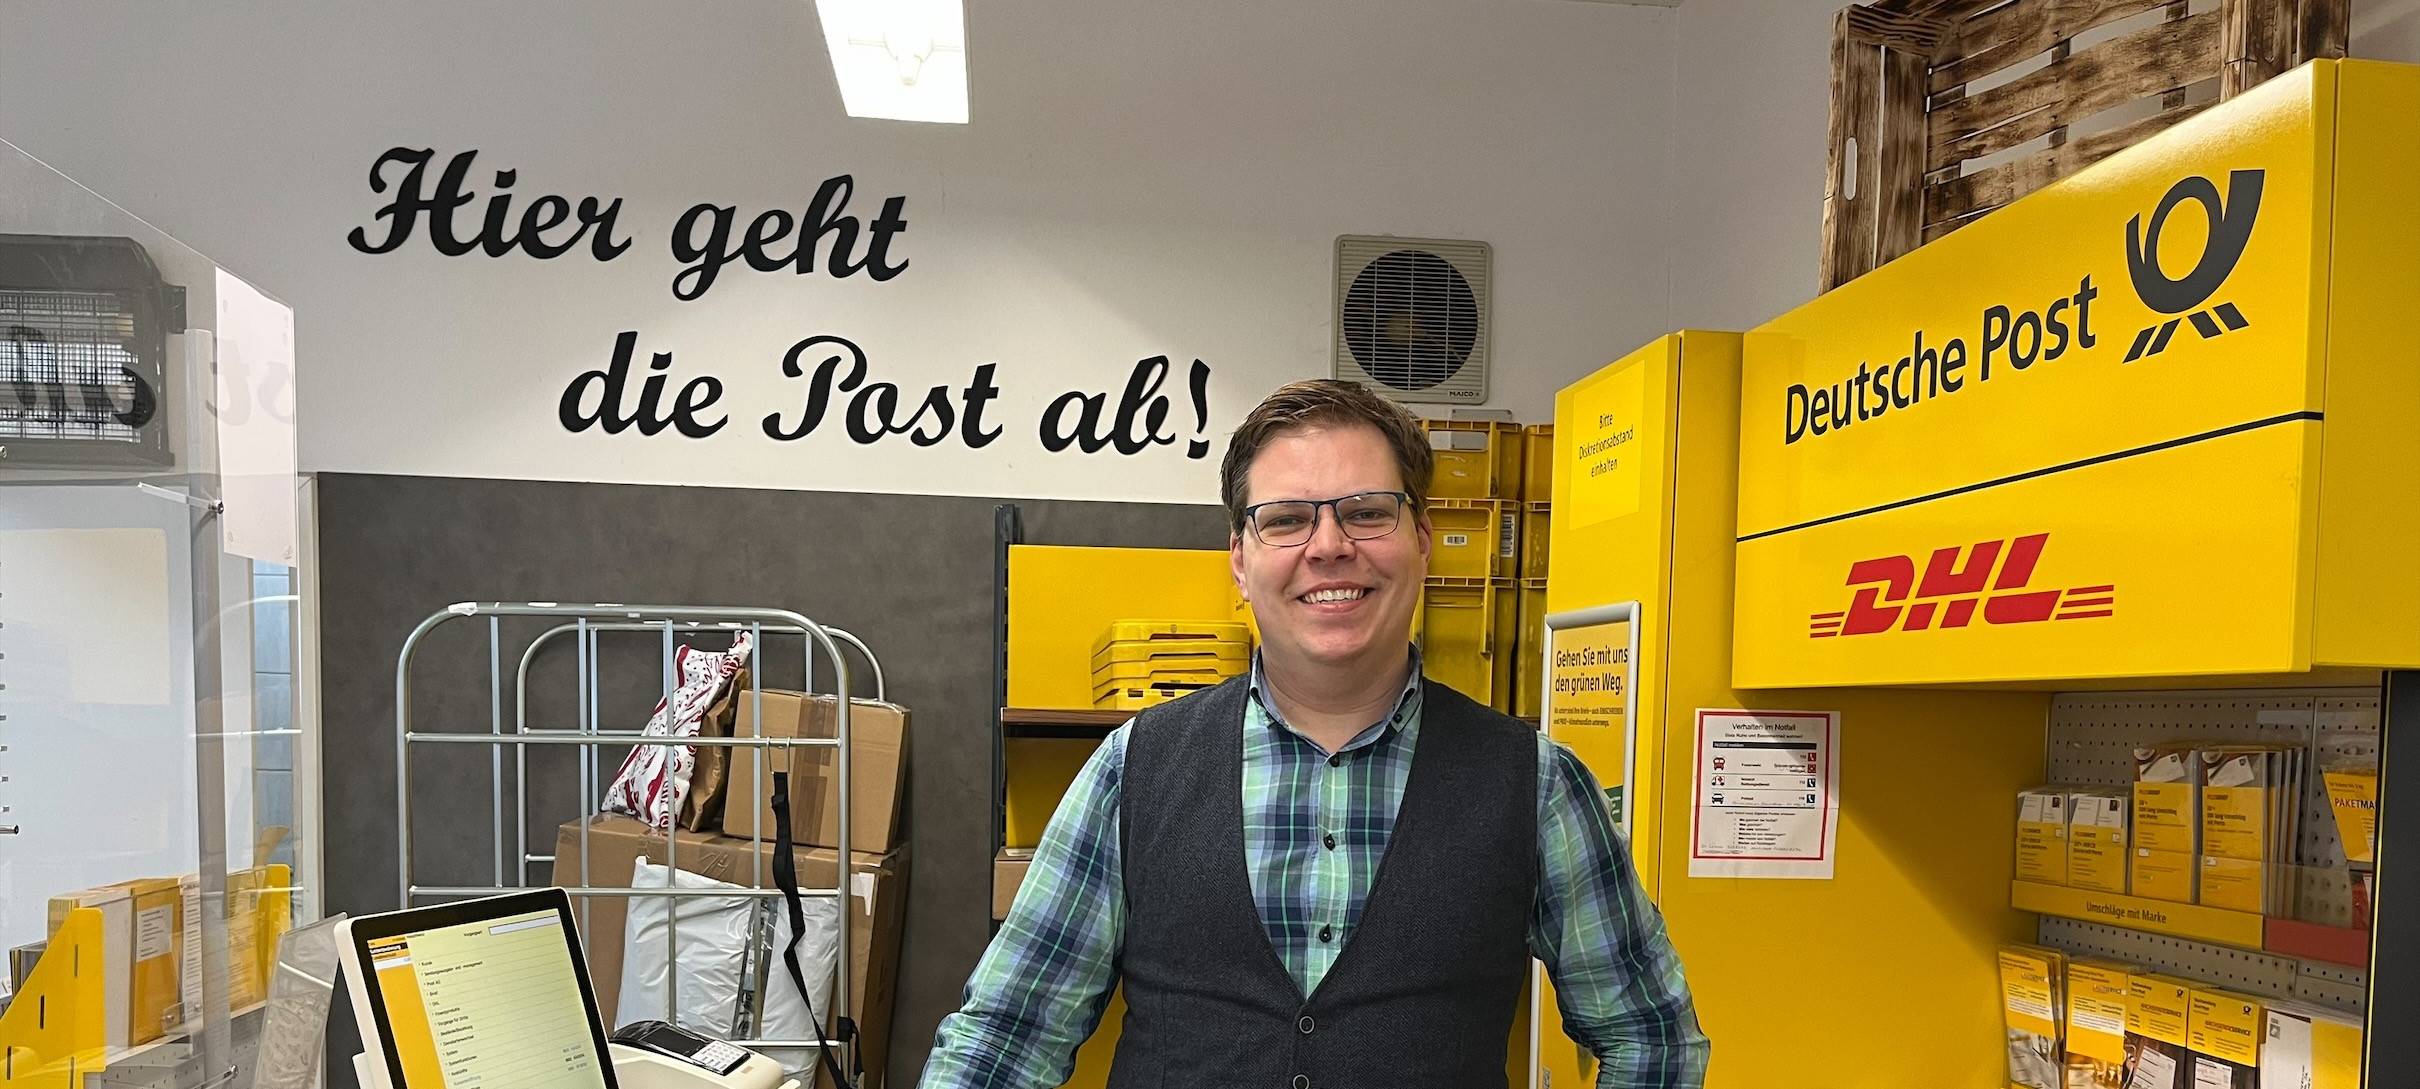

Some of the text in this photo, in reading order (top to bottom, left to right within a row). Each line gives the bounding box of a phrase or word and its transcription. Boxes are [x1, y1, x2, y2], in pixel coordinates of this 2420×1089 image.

[347, 146, 909, 301] Hier geht
[1784, 273, 2098, 445] Deutsche Post
[558, 331, 1211, 460] die Post ab!
[1599, 413, 1613, 430] Bitte
[1579, 424, 1634, 460] Diskretionsabstand
[1591, 458, 1618, 478] einhalten
[1841, 533, 2063, 636] DHL
[1556, 645, 1629, 668] Gehen Sie mit uns
[1555, 672, 1623, 696] den grünen Weg.
[2334, 797, 2376, 810] PAKETMA
[2086, 901, 2167, 924] Umschläge mit Marke
